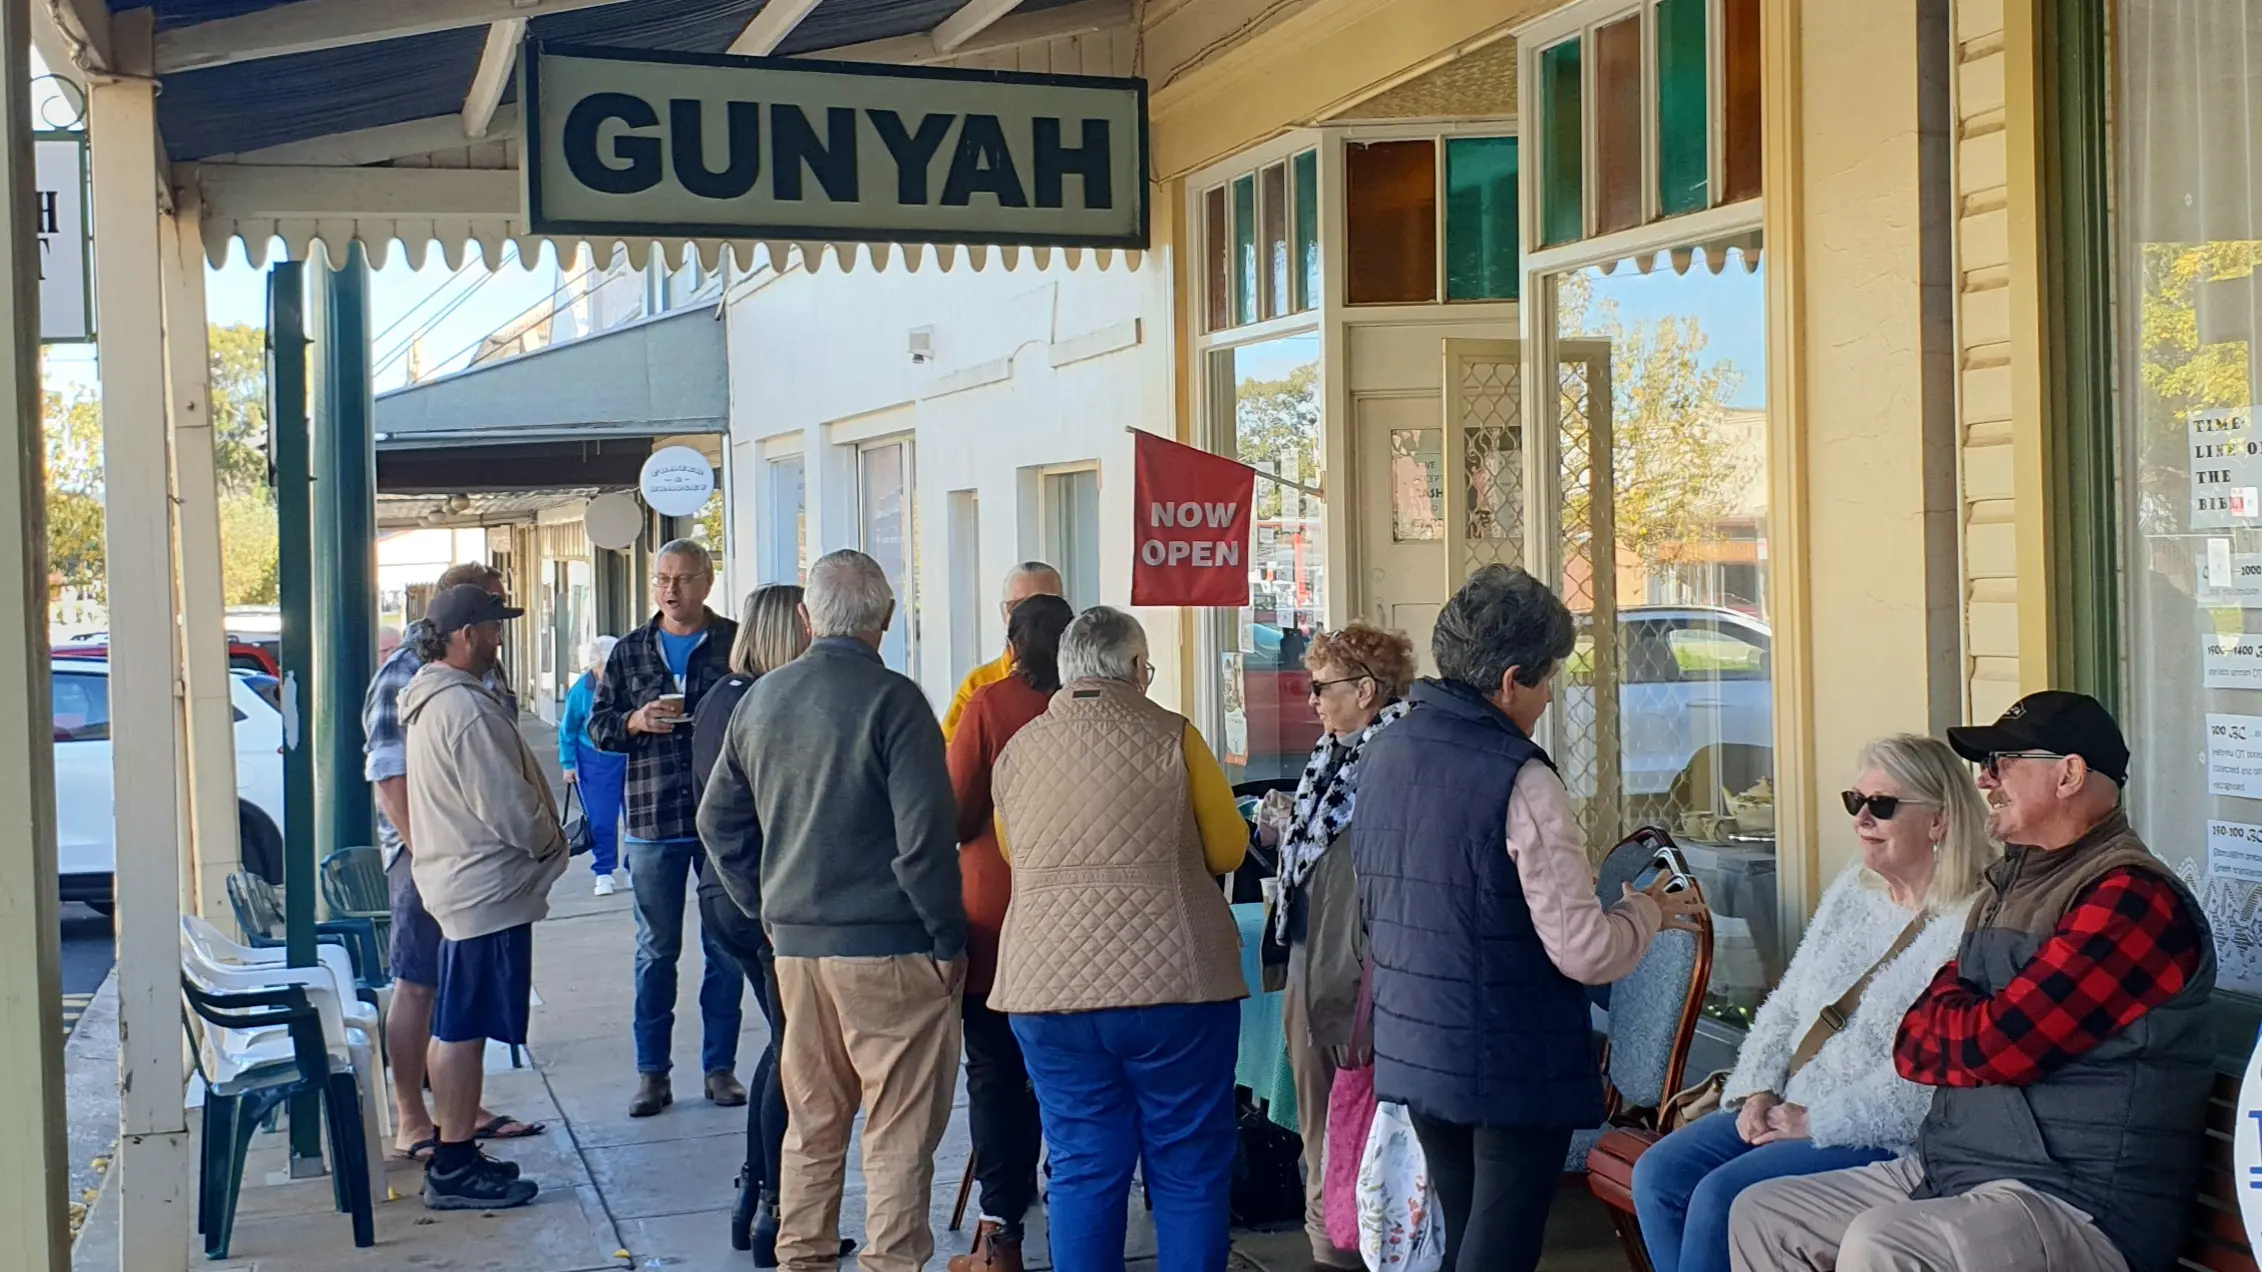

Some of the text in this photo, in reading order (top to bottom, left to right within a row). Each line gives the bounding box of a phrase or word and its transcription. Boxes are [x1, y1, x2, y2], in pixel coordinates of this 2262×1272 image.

[562, 91, 1113, 210] GUNYAH
[2196, 469, 2232, 484] THE
[1151, 501, 1237, 528] NOW
[1142, 539, 1239, 566] OPEN
